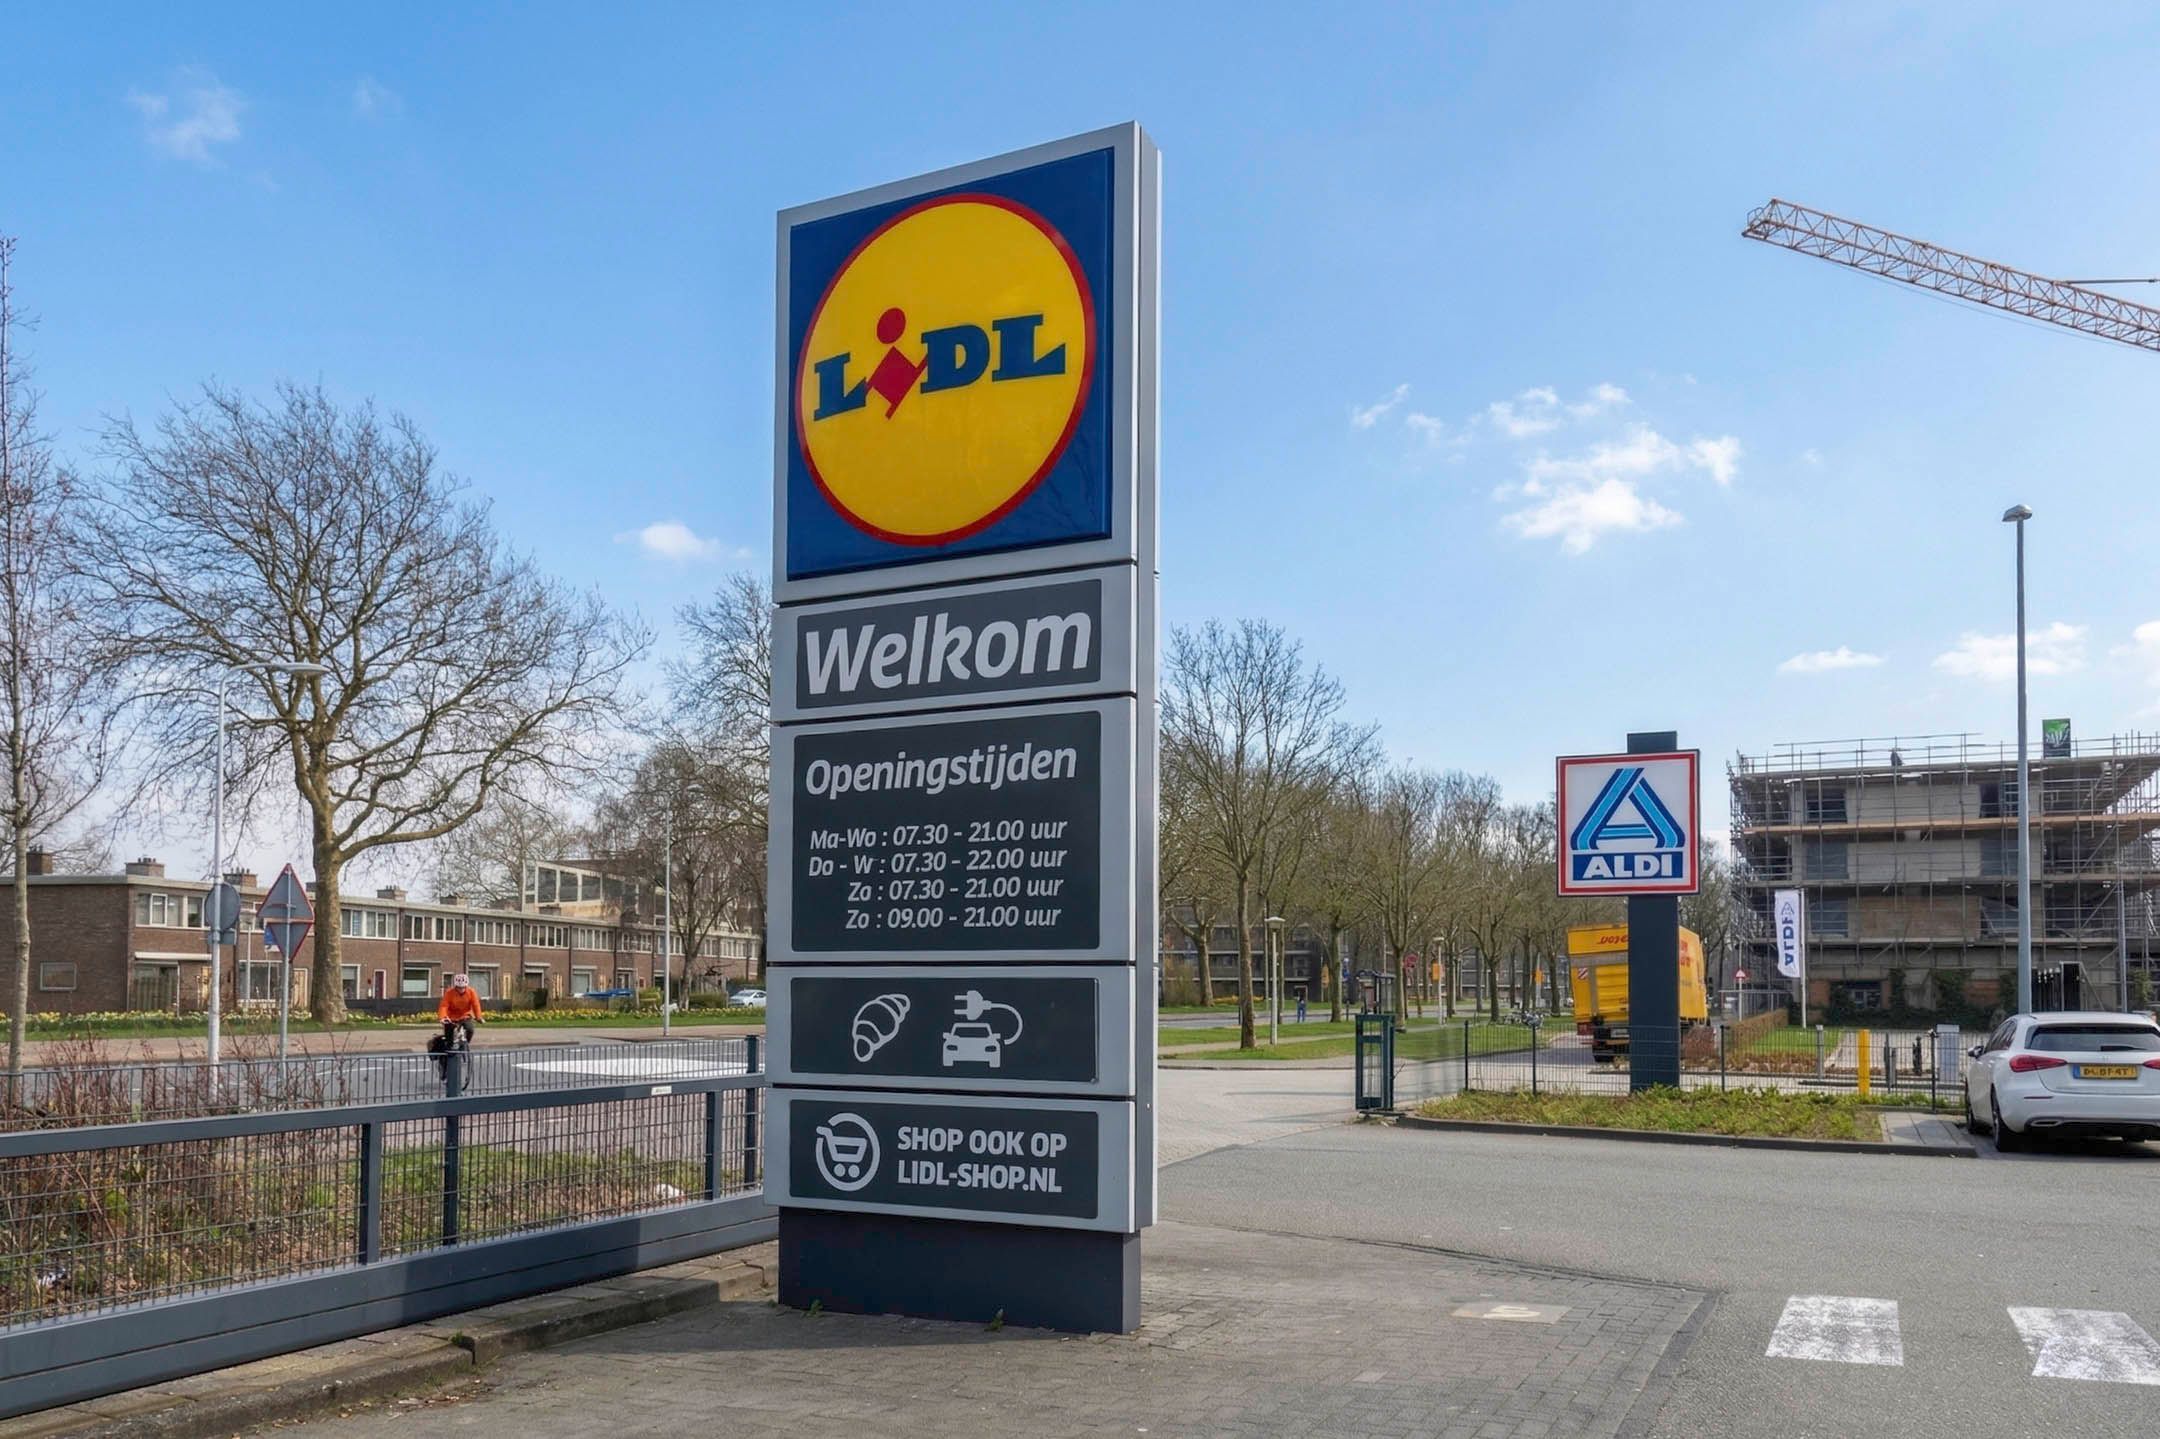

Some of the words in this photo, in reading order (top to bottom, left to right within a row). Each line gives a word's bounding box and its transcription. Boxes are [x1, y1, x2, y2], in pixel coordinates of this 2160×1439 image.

[806, 611, 1091, 695] Welkom
[806, 742, 1077, 800] Openingstijden
[893, 824, 948, 846] 07.30
[968, 820, 1024, 842] 21.00
[1031, 821, 1068, 839] uur
[809, 856, 834, 876] Do
[891, 851, 947, 873] 07.30
[966, 848, 1024, 870] 22.00
[1030, 850, 1068, 868] uur
[1583, 854, 1672, 878] ALDI
[889, 879, 945, 900] 07.30
[964, 876, 1020, 898] 21.00
[1027, 879, 1064, 896] uur
[846, 909, 870, 928] Zo
[887, 907, 943, 928] 09.00
[963, 906, 1019, 927] 21.00
[1024, 909, 1061, 926] uur
[897, 1126, 963, 1152] SHOP
[969, 1130, 1024, 1156] OOK
[1031, 1132, 1067, 1158] OP
[898, 1160, 1062, 1193] LIDL-SHOP.NL
